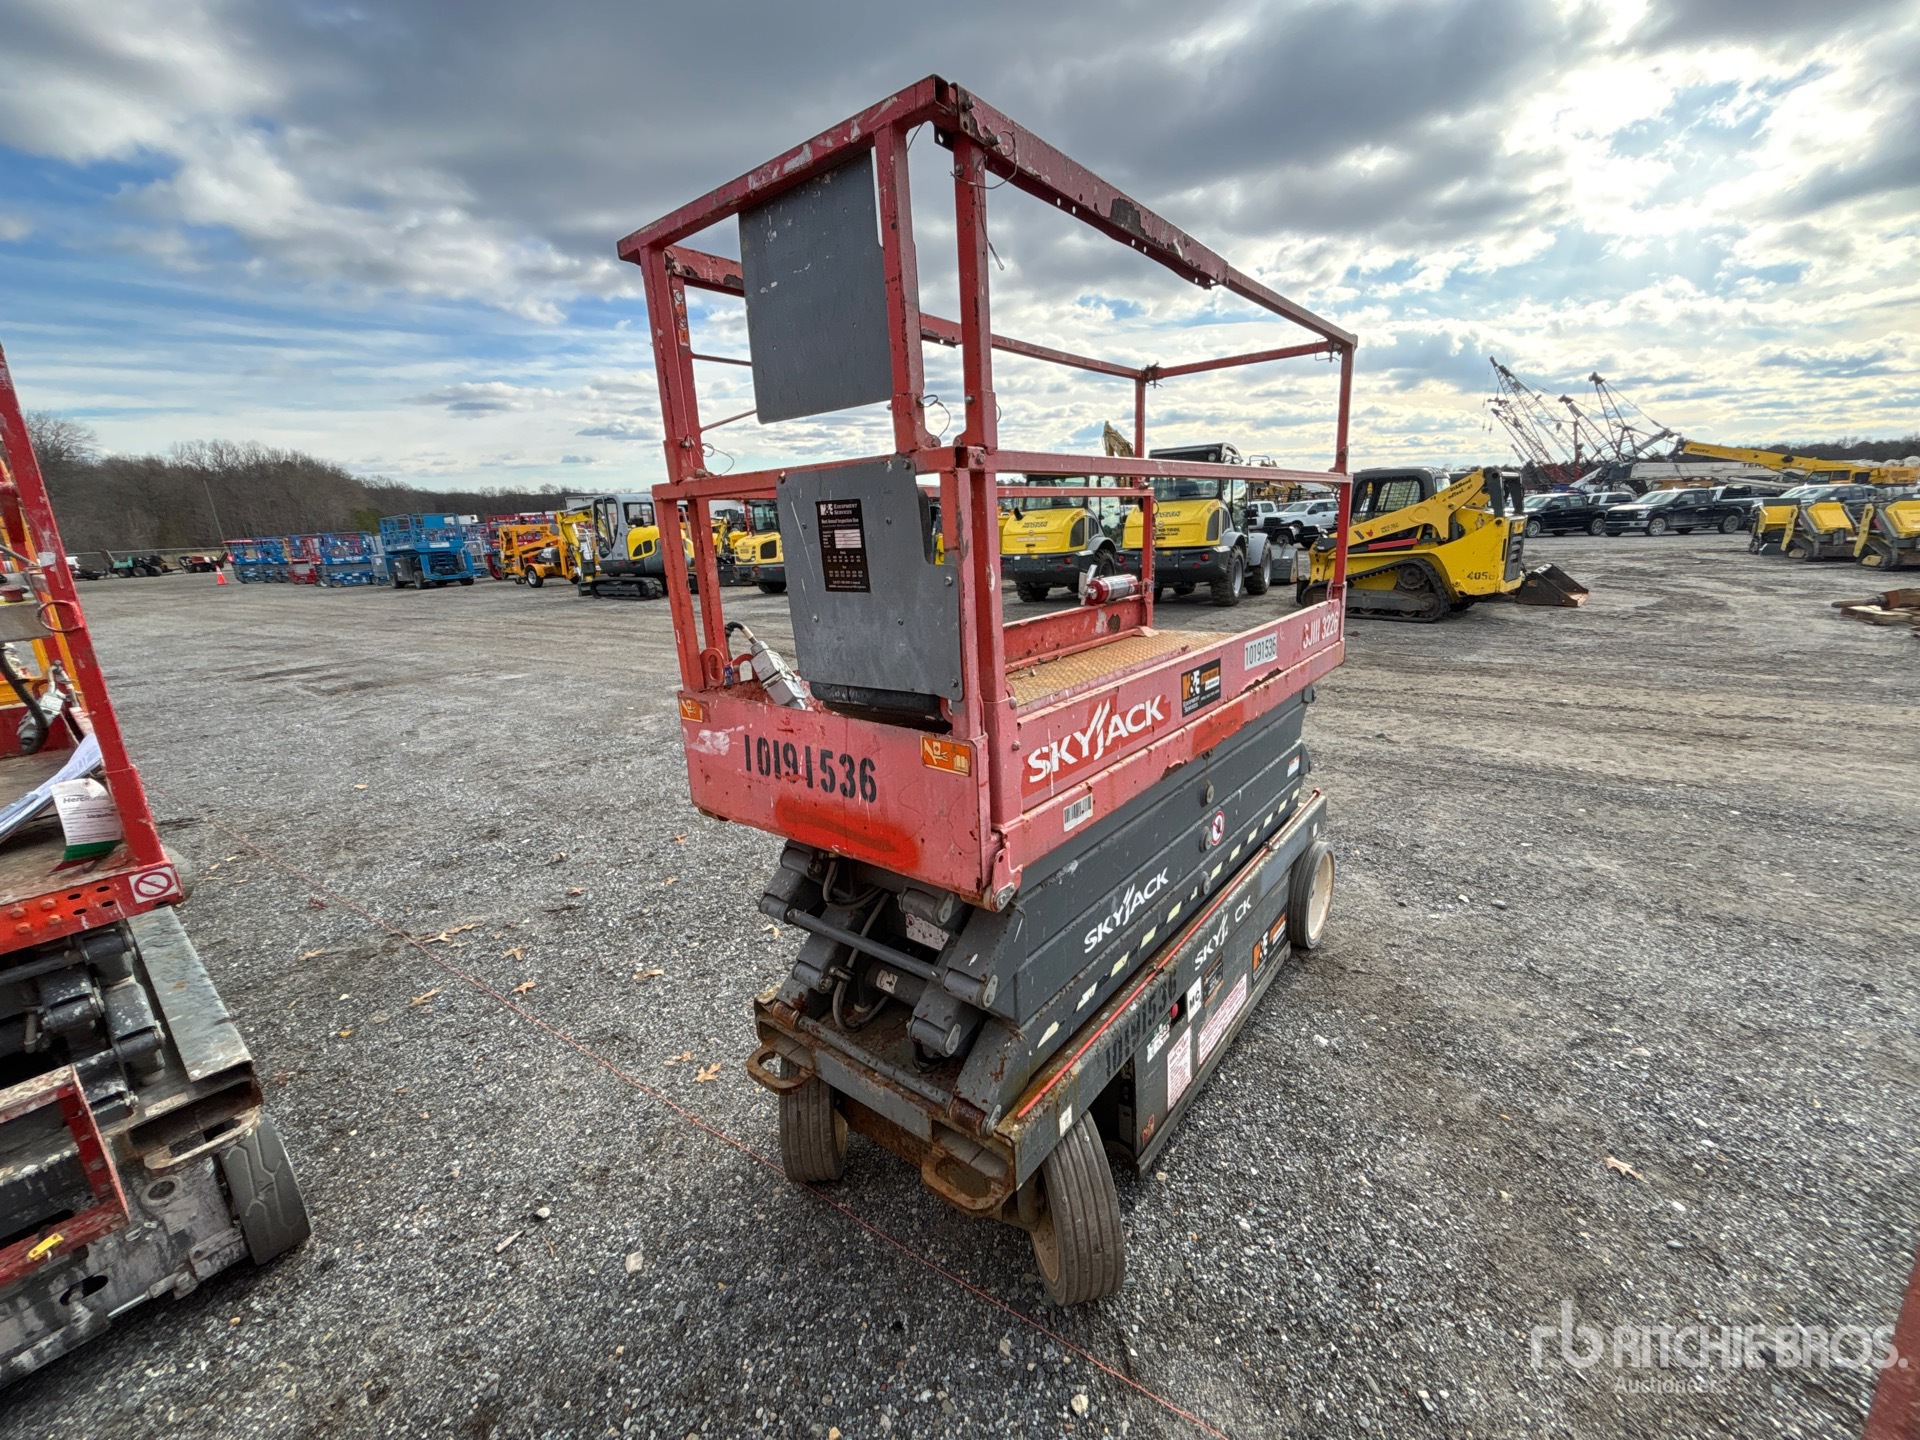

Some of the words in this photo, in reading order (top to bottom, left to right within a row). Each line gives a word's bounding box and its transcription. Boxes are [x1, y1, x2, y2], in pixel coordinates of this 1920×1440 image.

[1245, 636, 1277, 666] 10191536
[1321, 611, 1339, 640] 3226
[744, 733, 877, 804] 10191536
[1027, 695, 1165, 783] SKYJACK
[1084, 866, 1170, 954] SKYJACK
[1194, 894, 1252, 972] SKYJCK
[1189, 989, 1201, 1011] MC
